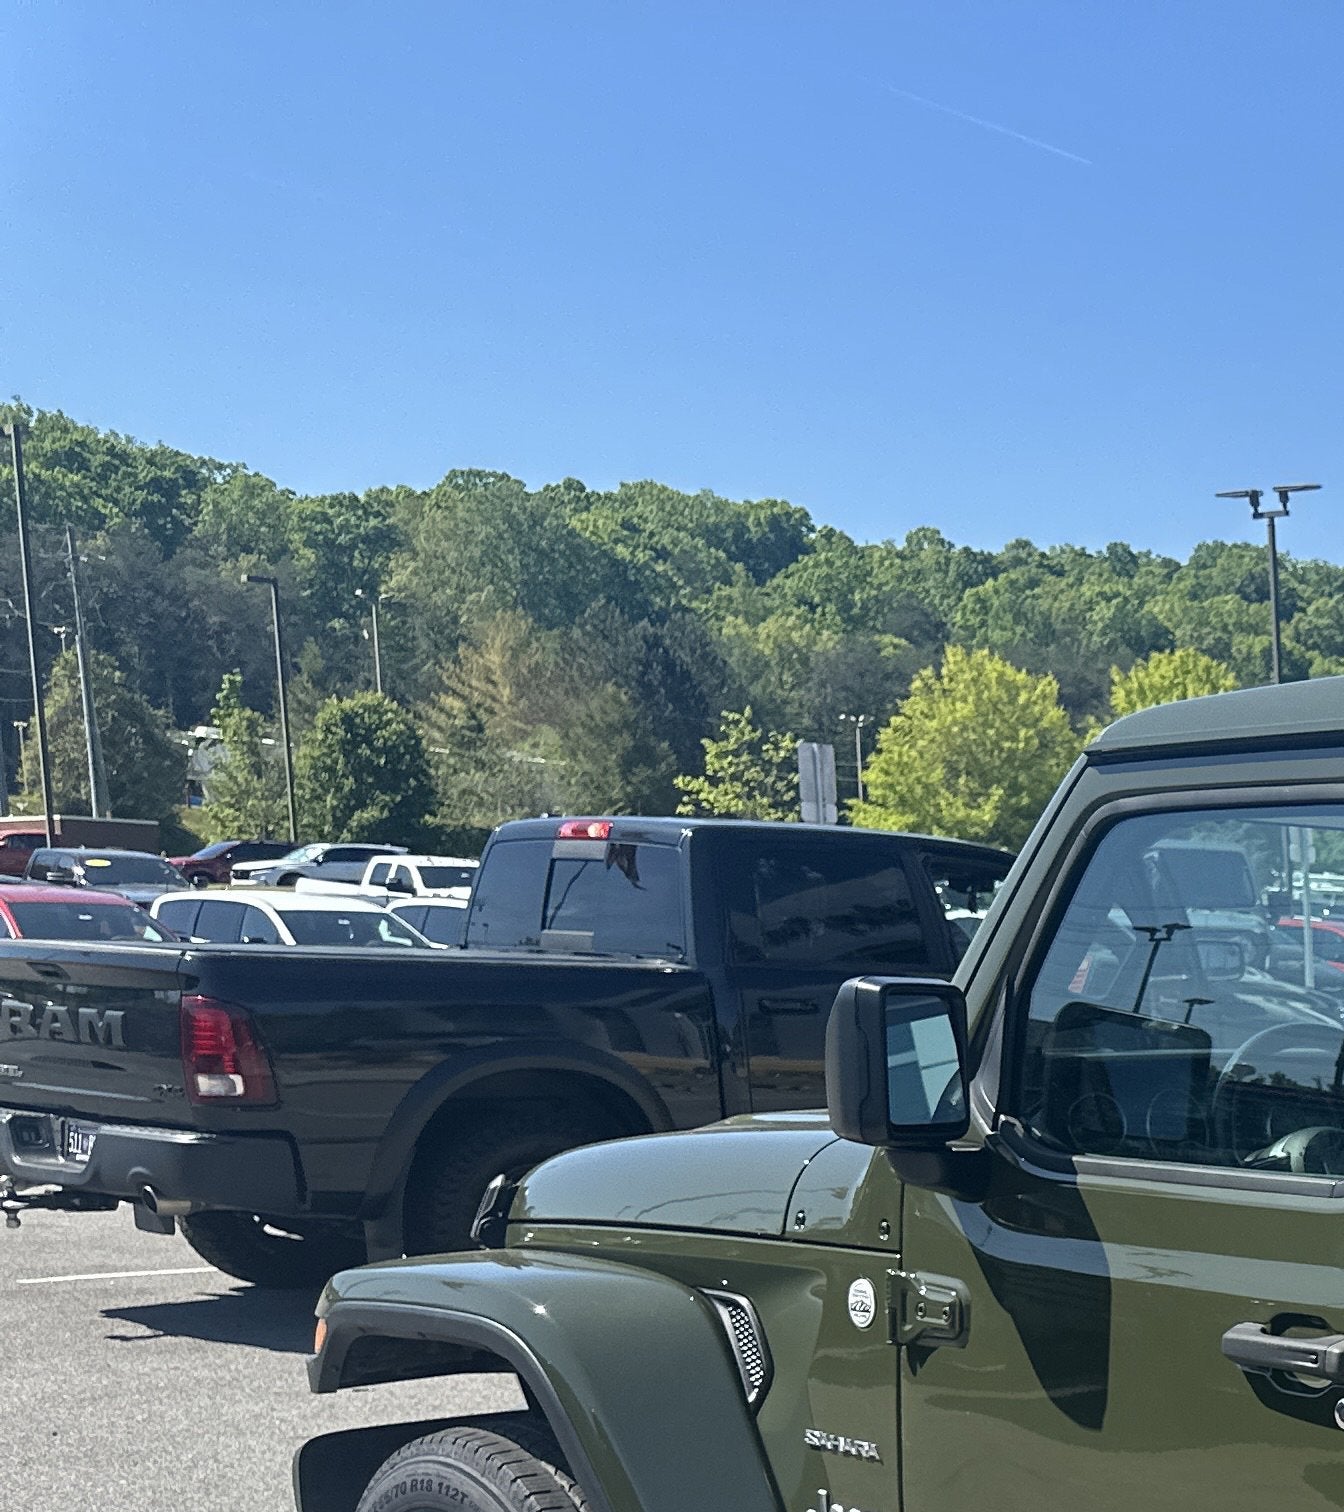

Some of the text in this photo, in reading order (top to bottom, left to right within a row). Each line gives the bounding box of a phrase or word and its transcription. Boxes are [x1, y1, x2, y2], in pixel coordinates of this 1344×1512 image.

[0, 1000, 127, 1048] RAM
[410, 1479, 434, 1494] R18
[437, 1482, 469, 1504] 112T
